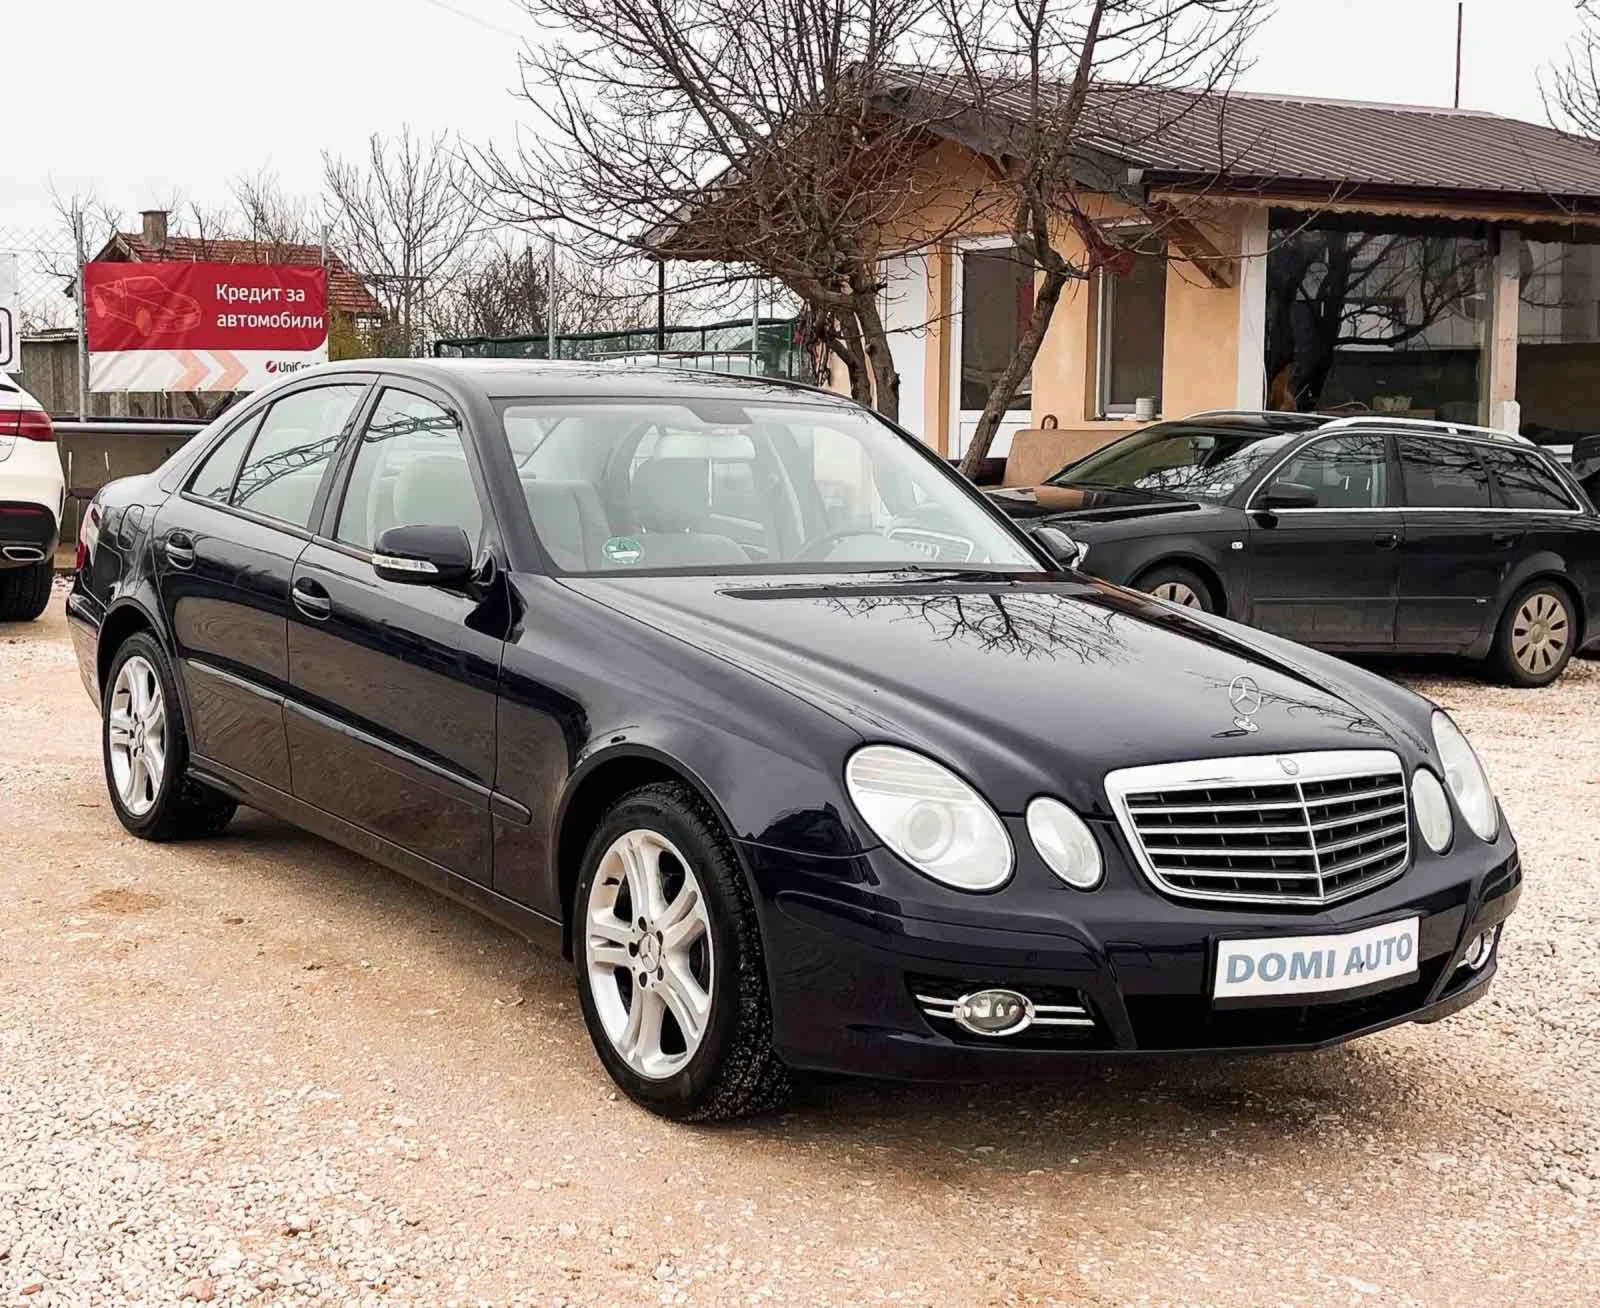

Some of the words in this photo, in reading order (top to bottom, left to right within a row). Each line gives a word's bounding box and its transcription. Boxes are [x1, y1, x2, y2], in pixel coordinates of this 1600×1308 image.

[216, 283, 282, 304] Кредит
[286, 288, 305, 302] за
[217, 311, 323, 329] автомобили
[1226, 950, 1336, 983] DOMI
[1344, 933, 1413, 976] AUTO
